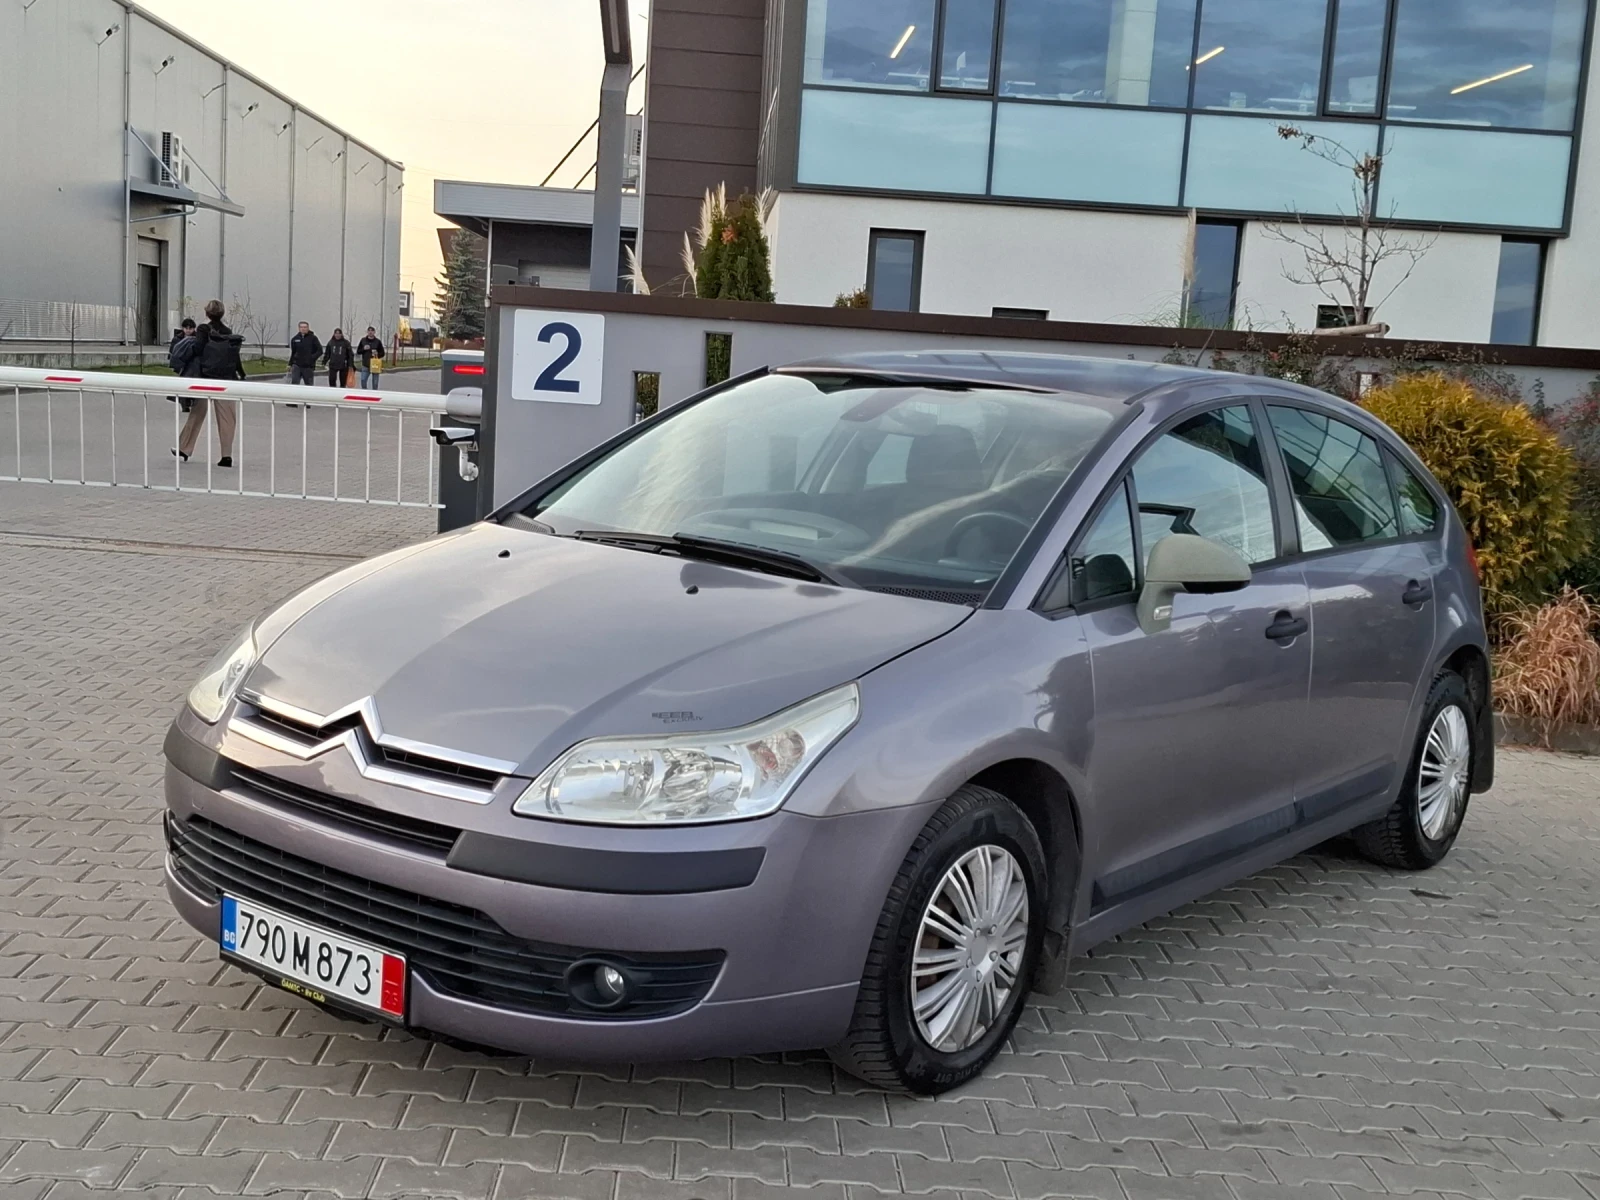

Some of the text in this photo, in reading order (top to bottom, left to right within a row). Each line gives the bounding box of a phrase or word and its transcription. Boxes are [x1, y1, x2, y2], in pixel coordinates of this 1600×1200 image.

[533, 321, 582, 393] 2
[224, 929, 236, 944] BG
[313, 991, 326, 1003] Club
